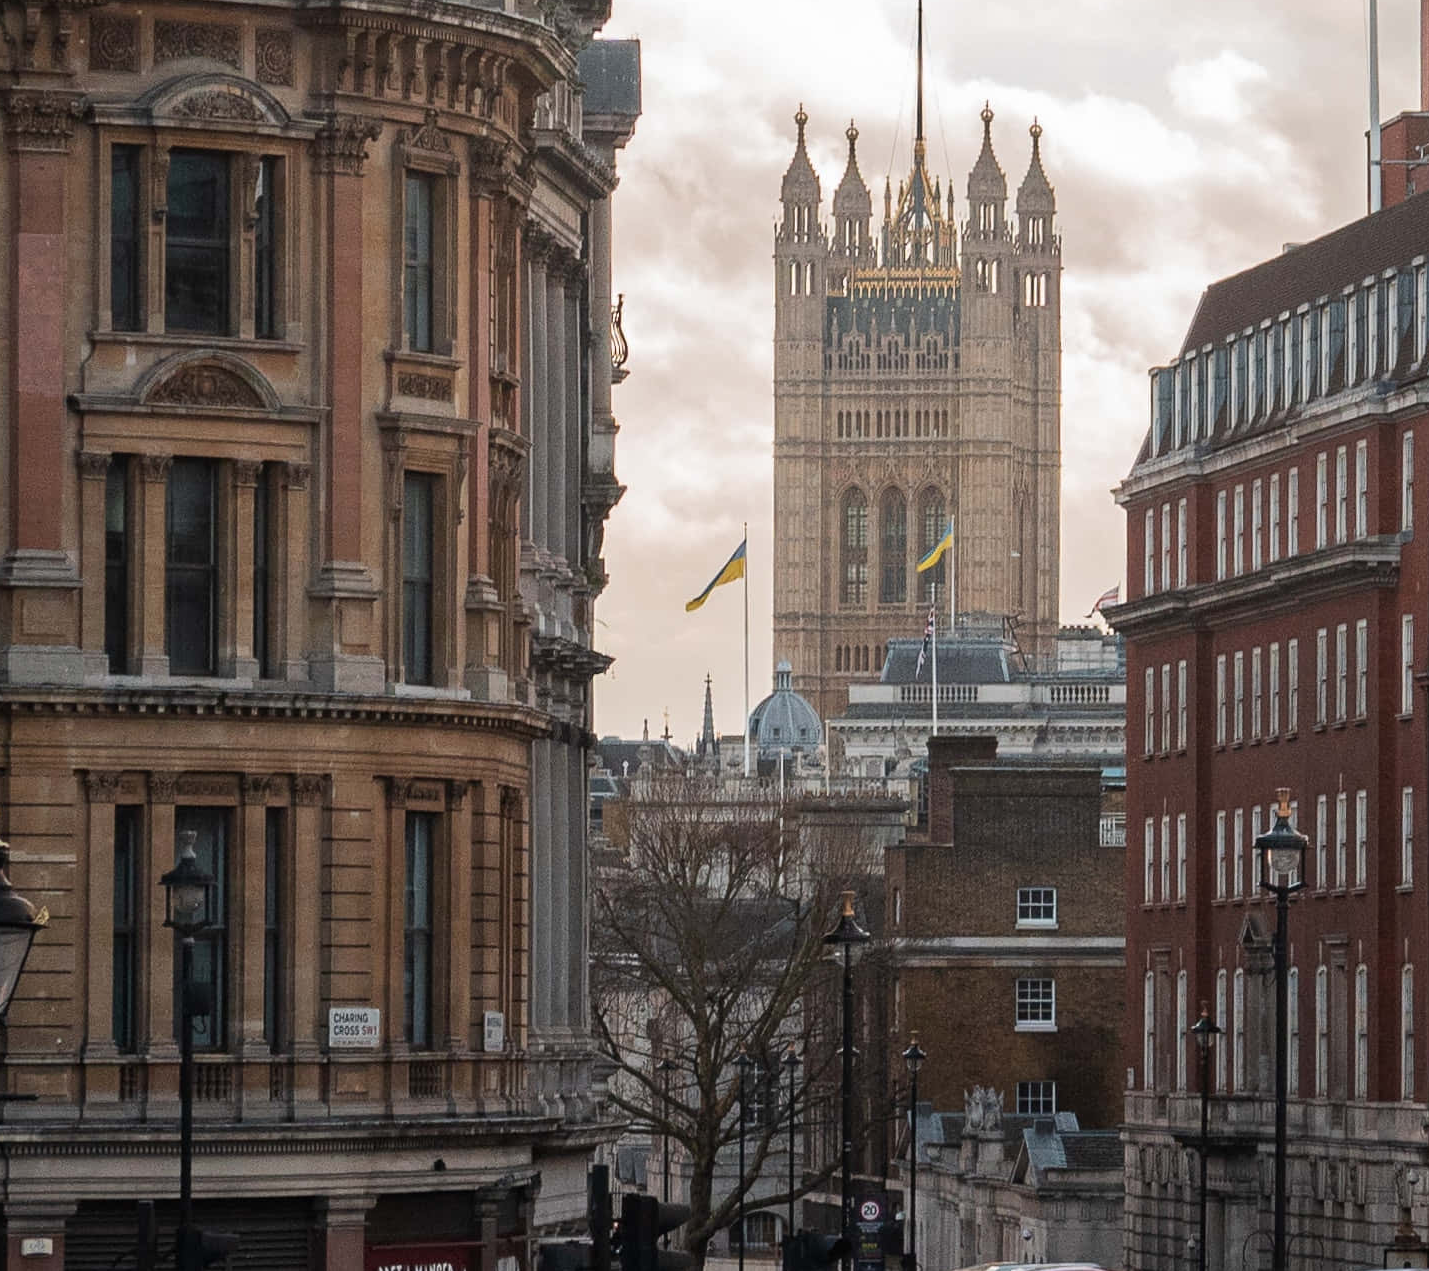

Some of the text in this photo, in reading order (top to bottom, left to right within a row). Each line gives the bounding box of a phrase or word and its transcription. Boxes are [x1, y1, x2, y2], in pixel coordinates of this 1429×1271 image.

[333, 1012, 368, 1023] CHARING
[333, 1025, 377, 1035] CROSS SW1
[864, 1205, 877, 1216] 20
